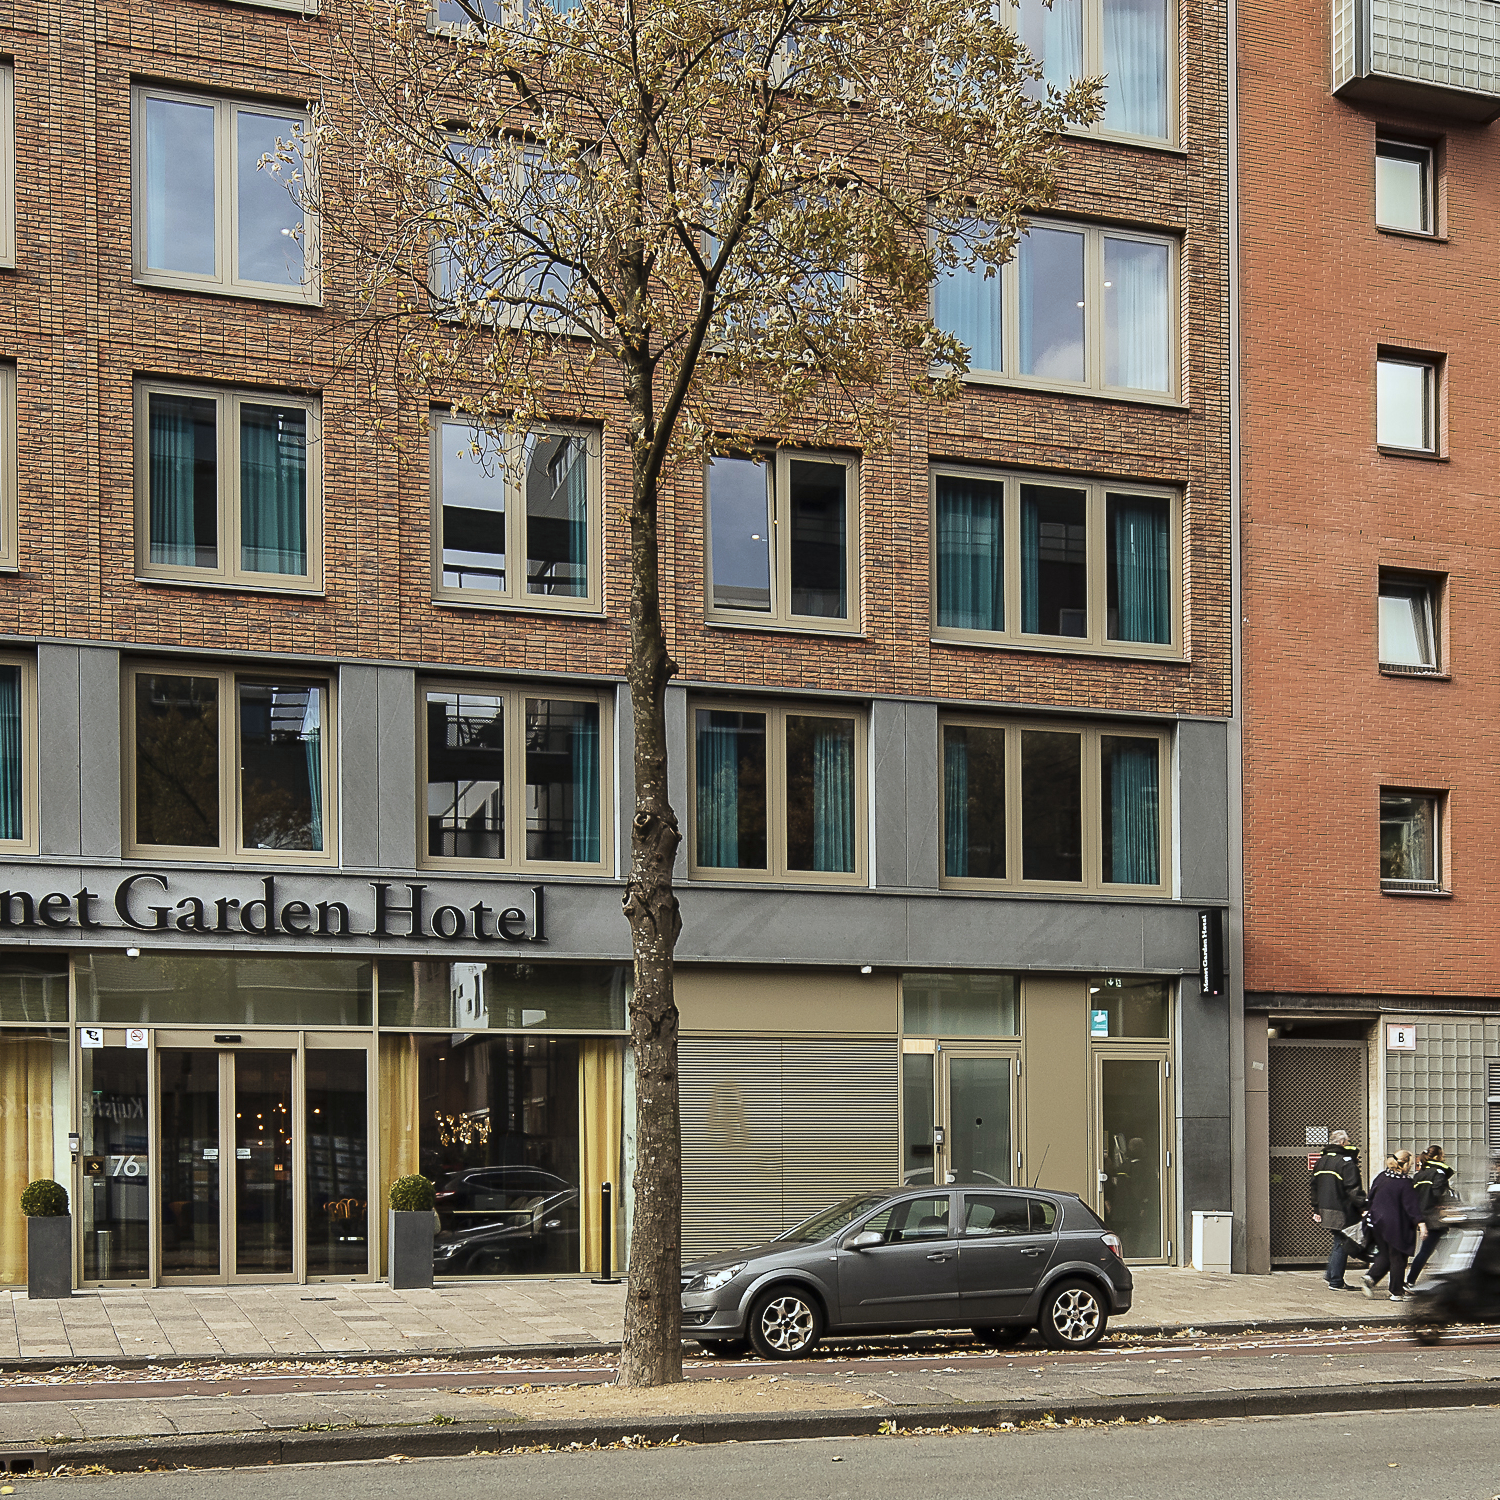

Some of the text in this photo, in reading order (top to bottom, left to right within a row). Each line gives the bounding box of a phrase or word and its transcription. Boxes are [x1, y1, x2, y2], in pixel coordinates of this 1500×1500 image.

[114, 873, 351, 937] Garden
[367, 882, 548, 942] Hotel
[1398, 1032, 1405, 1043] B
[110, 1155, 141, 1177] 76
